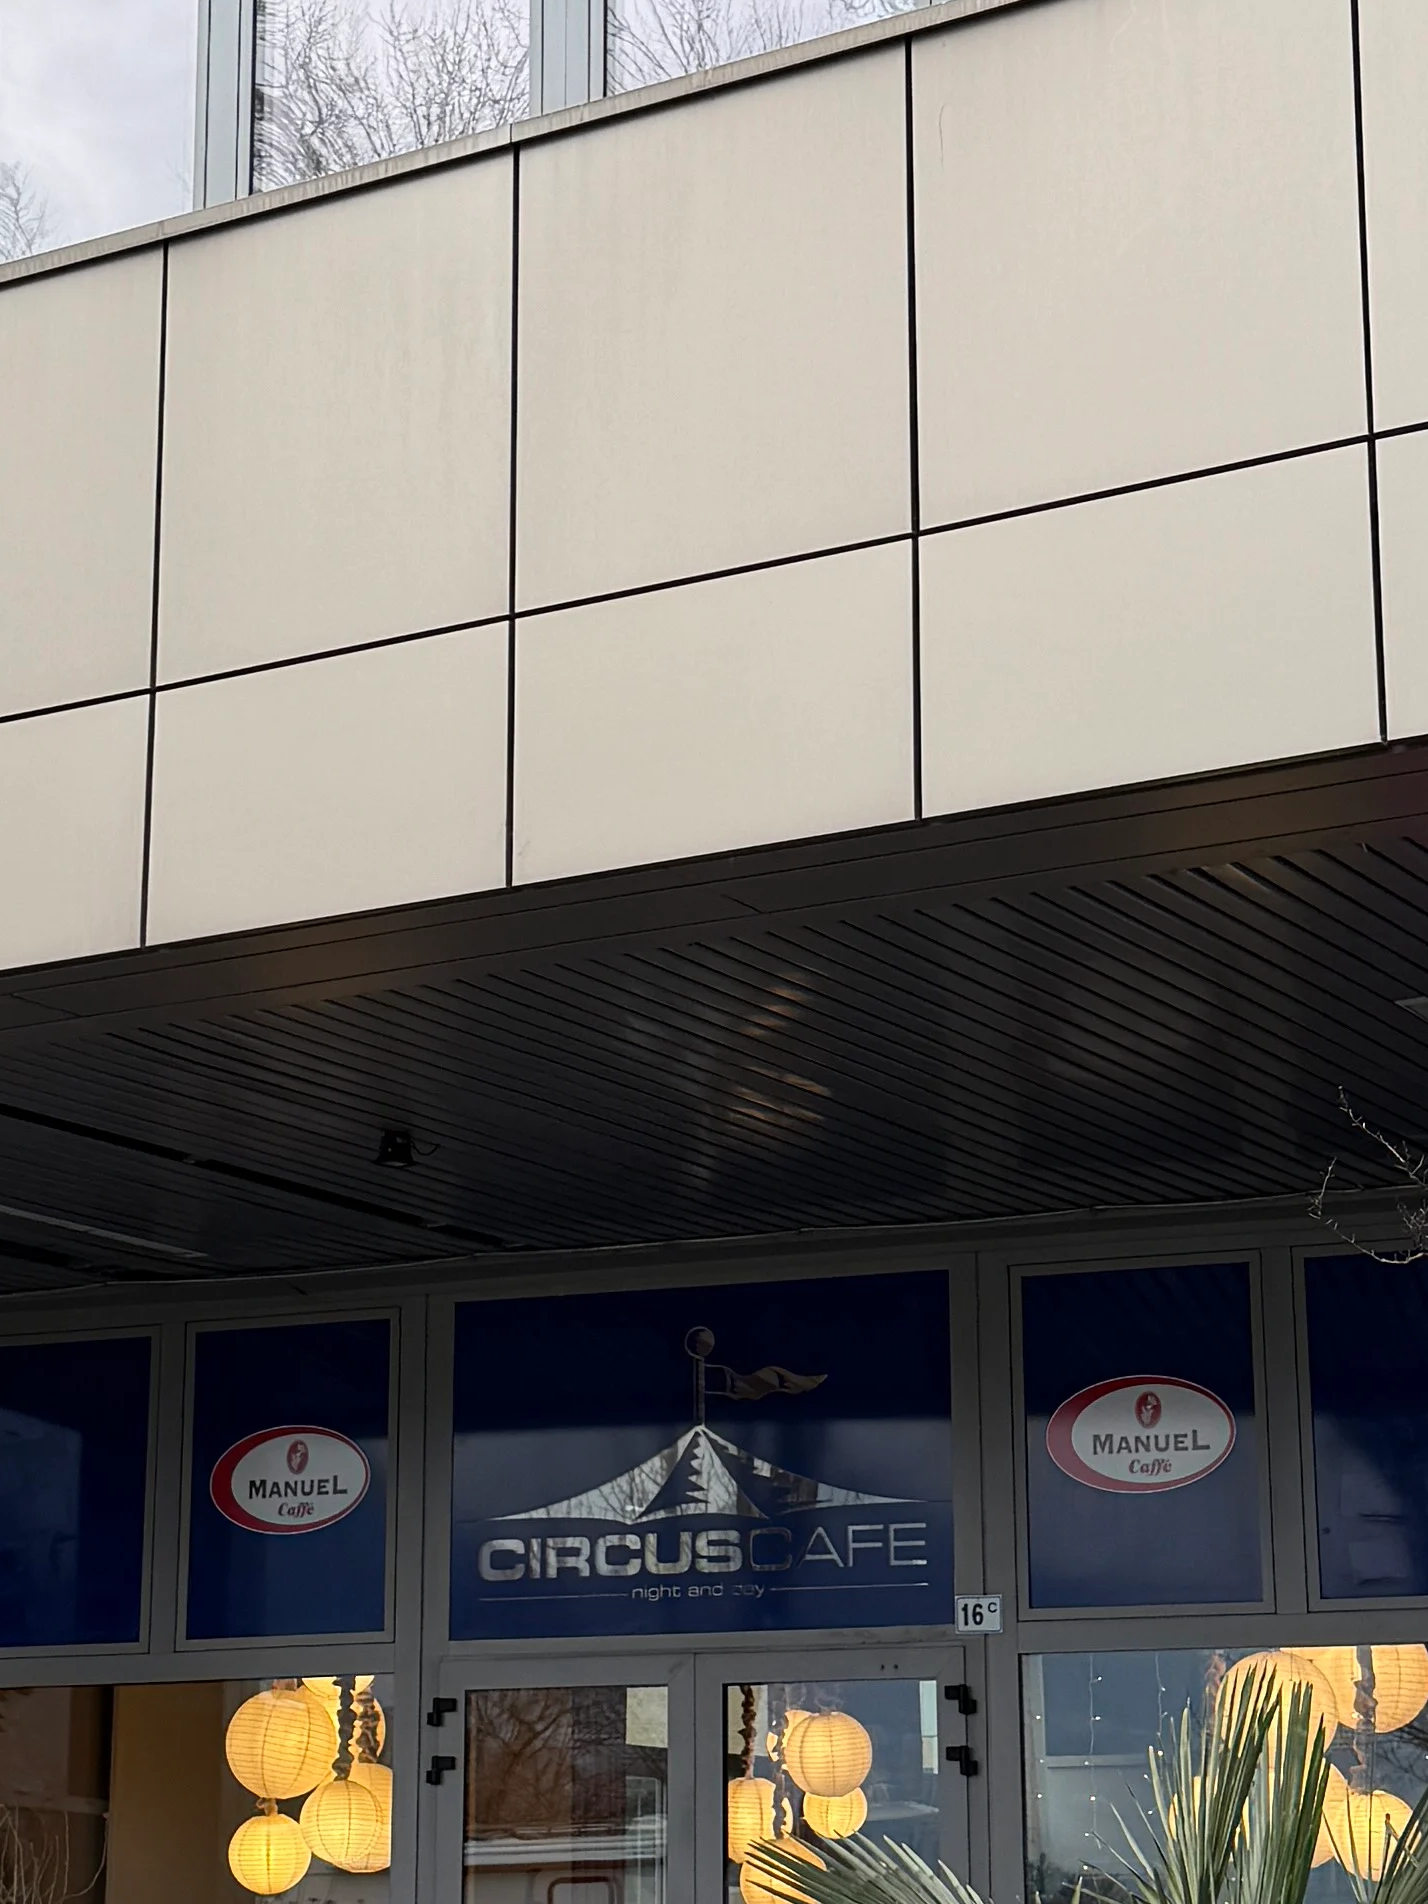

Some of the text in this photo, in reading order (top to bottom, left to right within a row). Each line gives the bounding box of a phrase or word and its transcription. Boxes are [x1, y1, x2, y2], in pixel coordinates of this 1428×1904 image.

[1091, 1429, 1211, 1456] MANUEL
[248, 1475, 348, 1500] MANUEL
[632, 1584, 681, 1602] night
[688, 1582, 723, 1598] and
